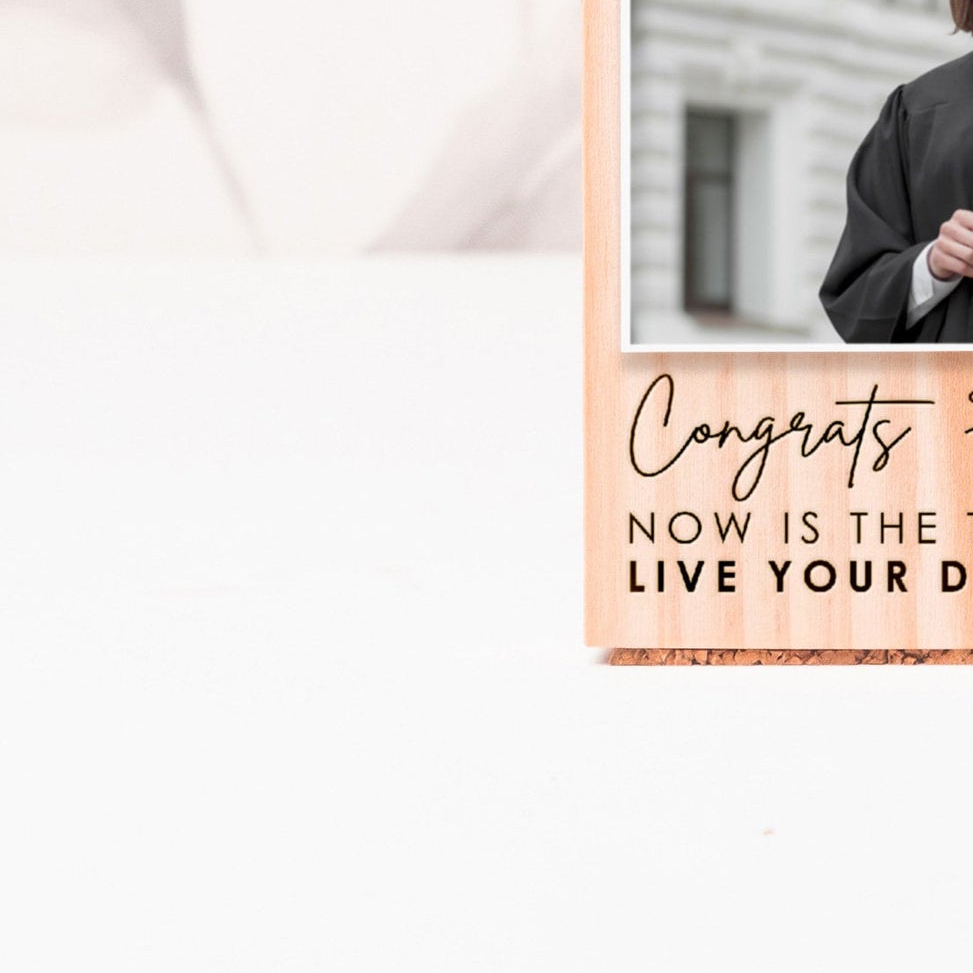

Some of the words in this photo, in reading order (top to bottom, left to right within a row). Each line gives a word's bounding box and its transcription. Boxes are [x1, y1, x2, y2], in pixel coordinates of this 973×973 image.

[629, 373, 935, 502] Congrats
[629, 511, 751, 545] NOW
[784, 511, 820, 545] IS
[849, 511, 937, 545] THE
[629, 559, 736, 594] LIVE
[768, 559, 908, 594] YOUR
